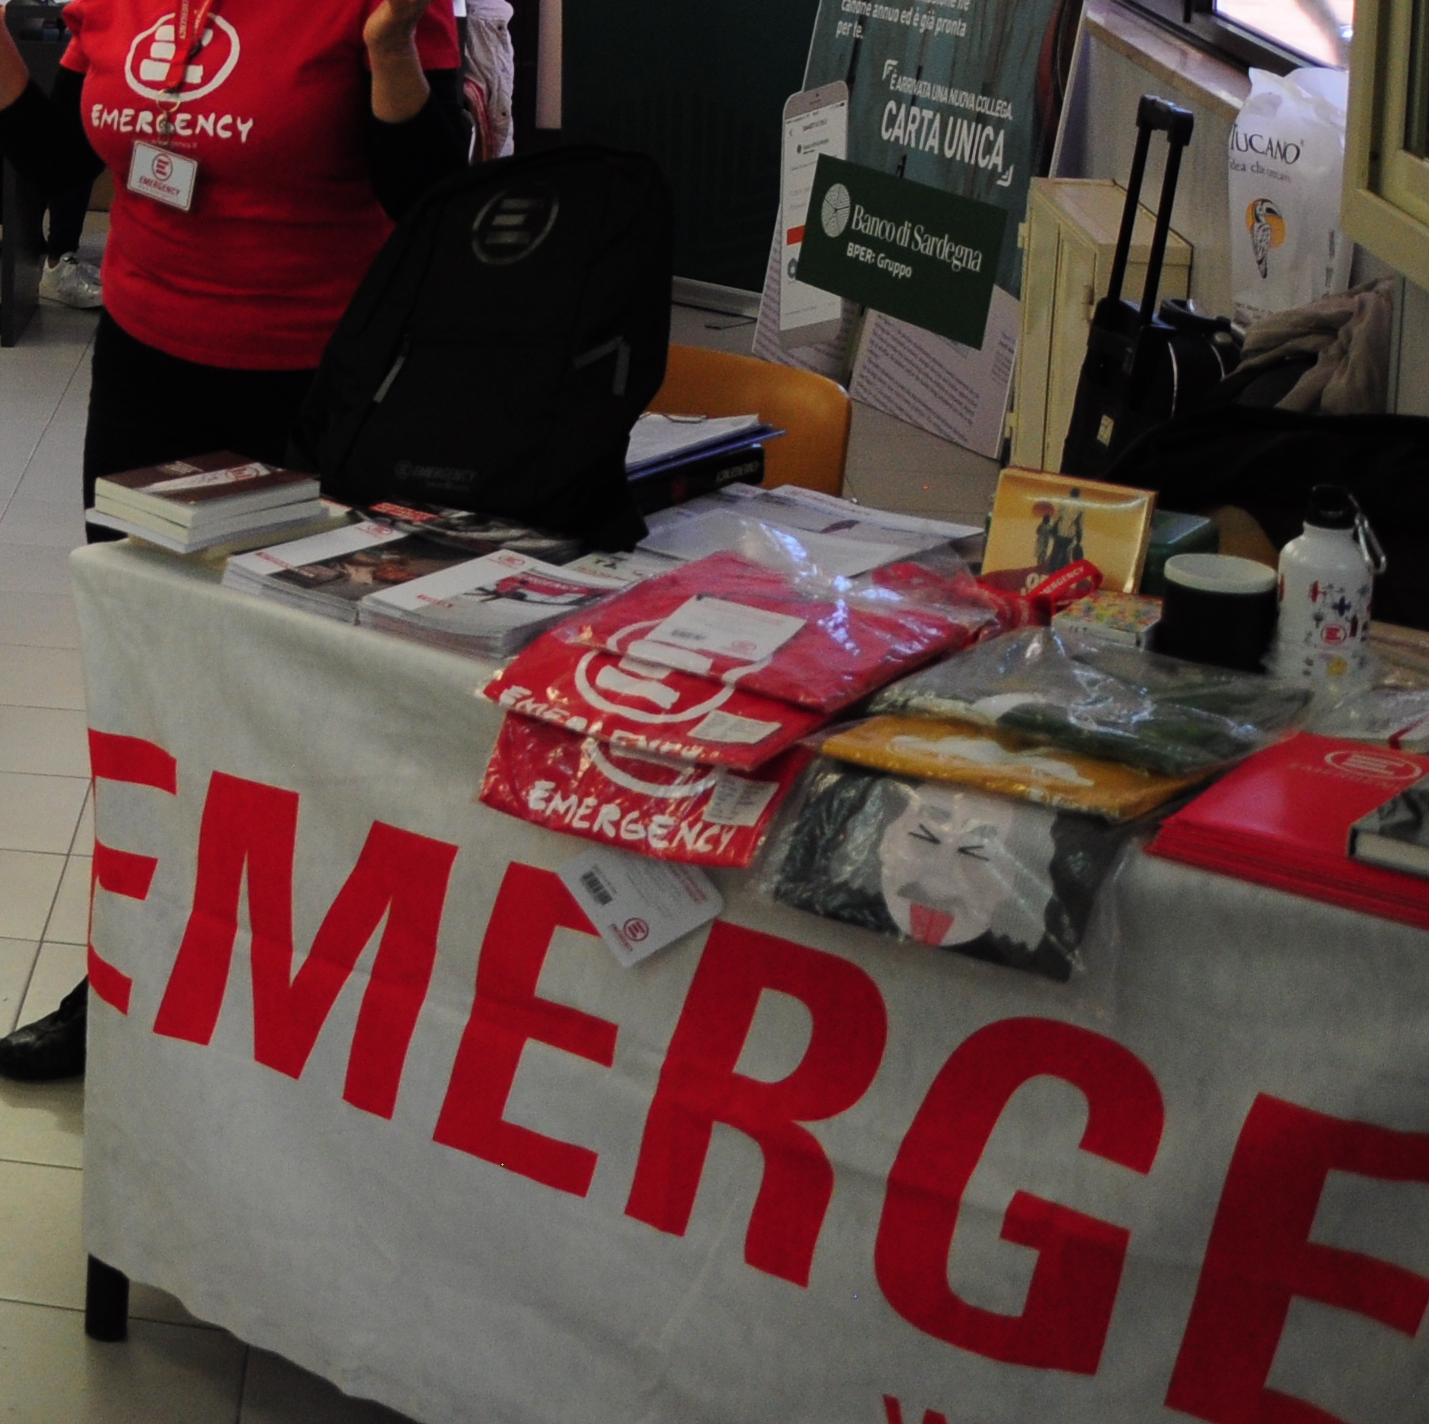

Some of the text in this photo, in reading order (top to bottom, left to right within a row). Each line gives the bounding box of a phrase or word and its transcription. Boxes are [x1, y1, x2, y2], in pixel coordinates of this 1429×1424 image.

[835, 19, 852, 38] per
[872, 3, 900, 23] annuo
[900, 7, 913, 26] ed
[919, 10, 935, 33] già
[934, 15, 967, 38] pronta
[897, 75, 932, 100] ARRIVATA
[931, 83, 950, 105] UNA
[950, 88, 977, 110] NUOVA
[91, 103, 253, 143] EMERGENCY
[880, 100, 941, 154] CARTA
[943, 115, 1005, 173] UNICA
[850, 203, 984, 273] Banco di Sardegna
[846, 241, 913, 280] BPER: Gruppo
[528, 779, 736, 855] EMERGENCY
